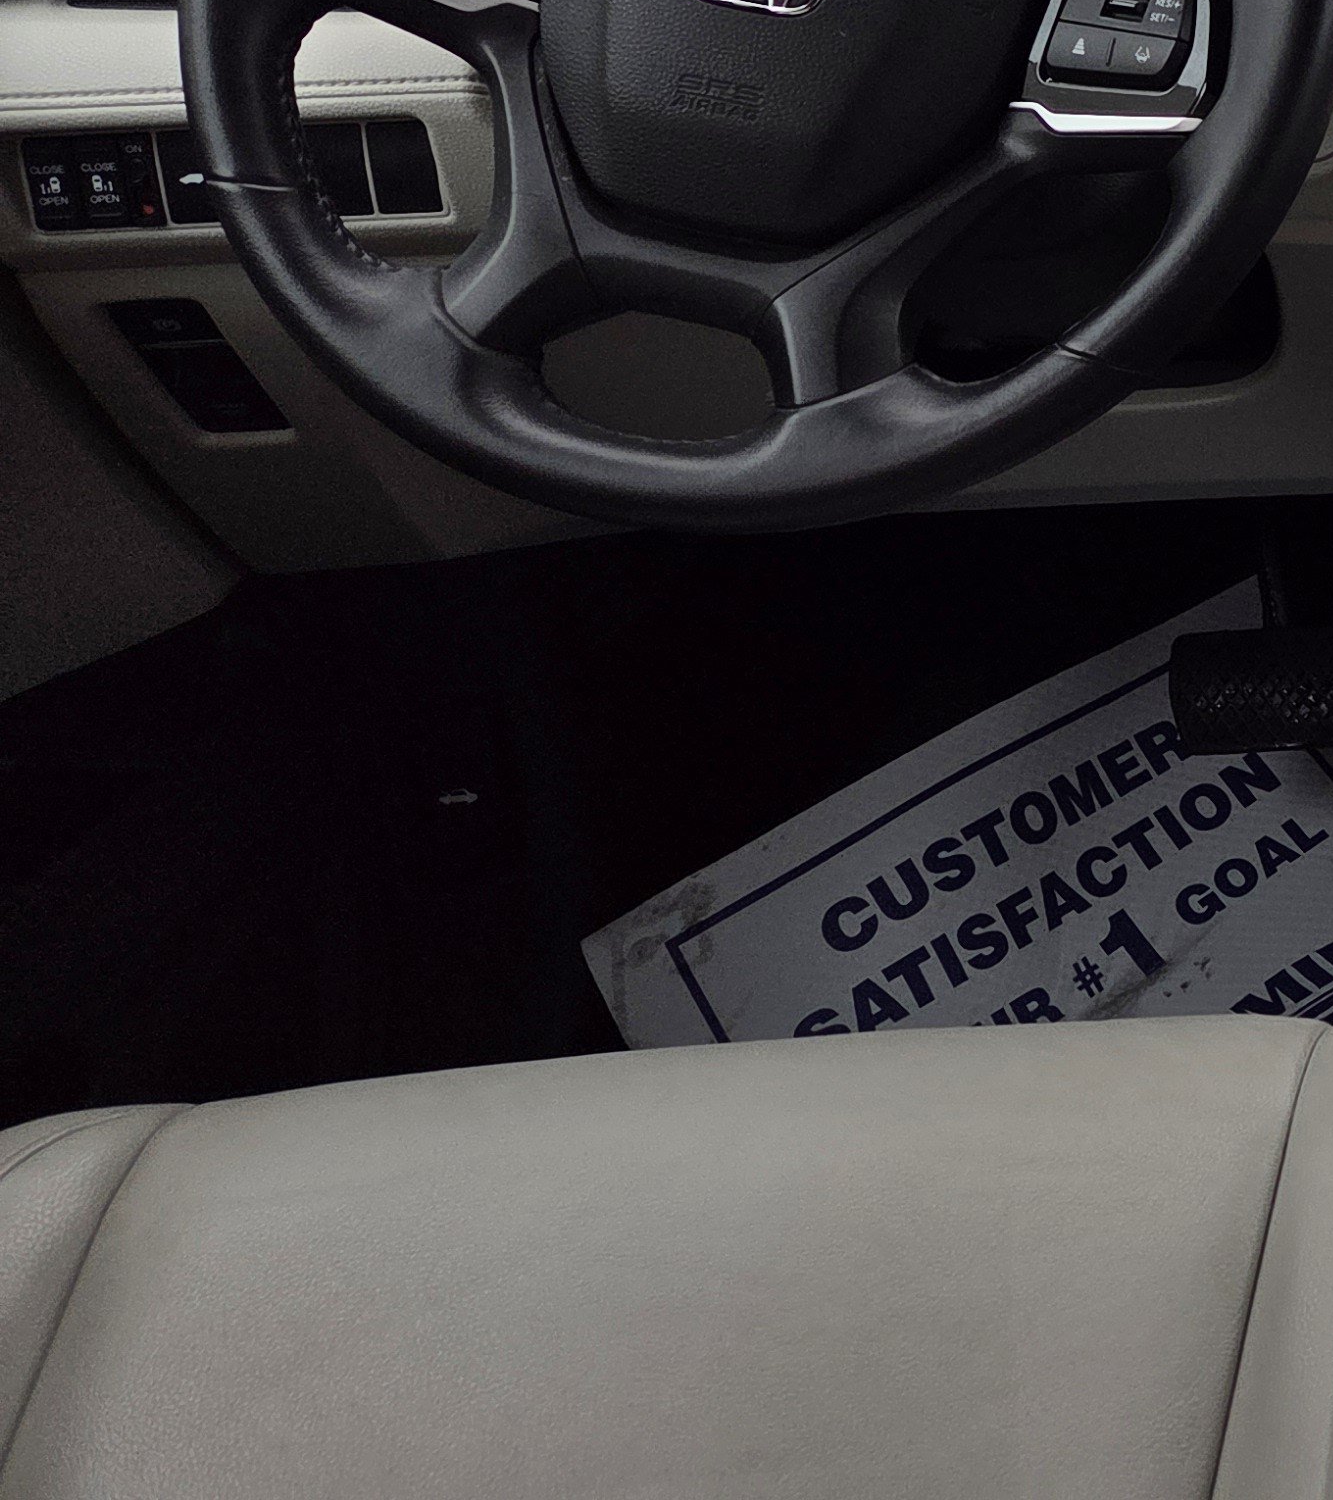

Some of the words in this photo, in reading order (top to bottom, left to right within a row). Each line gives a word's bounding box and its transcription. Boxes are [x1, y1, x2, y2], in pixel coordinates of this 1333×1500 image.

[29, 165, 65, 175] CLOSE
[81, 162, 117, 173] CLOSE
[39, 196, 69, 206] OPEN
[90, 194, 120, 204] OPEN
[820, 719, 1193, 952] CUSTOMER
[1174, 818, 1329, 925] GOAL
[793, 751, 1282, 1037] SATISFACTION
